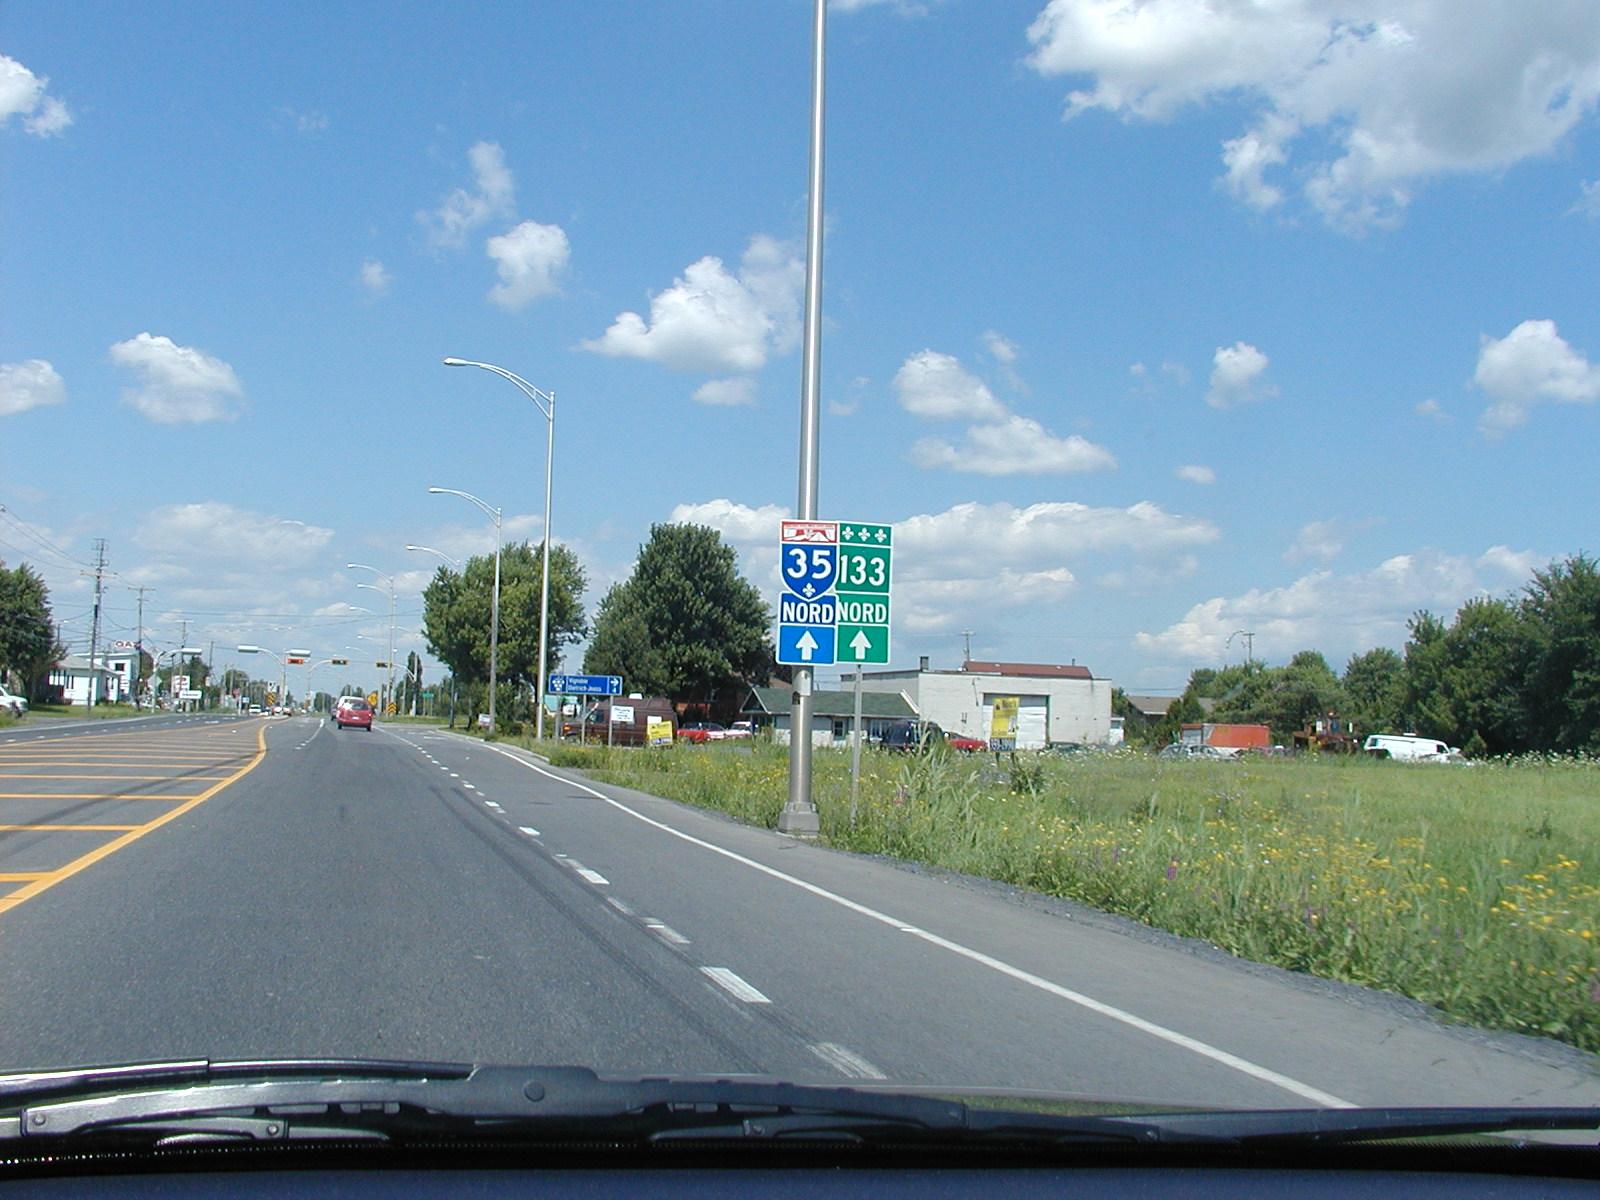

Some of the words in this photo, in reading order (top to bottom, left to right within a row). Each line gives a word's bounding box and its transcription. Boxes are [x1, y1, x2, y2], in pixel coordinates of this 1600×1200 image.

[787, 548, 832, 579] 35
[840, 554, 886, 586] 133
[783, 601, 834, 624] NORD
[838, 601, 887, 624] NORD
